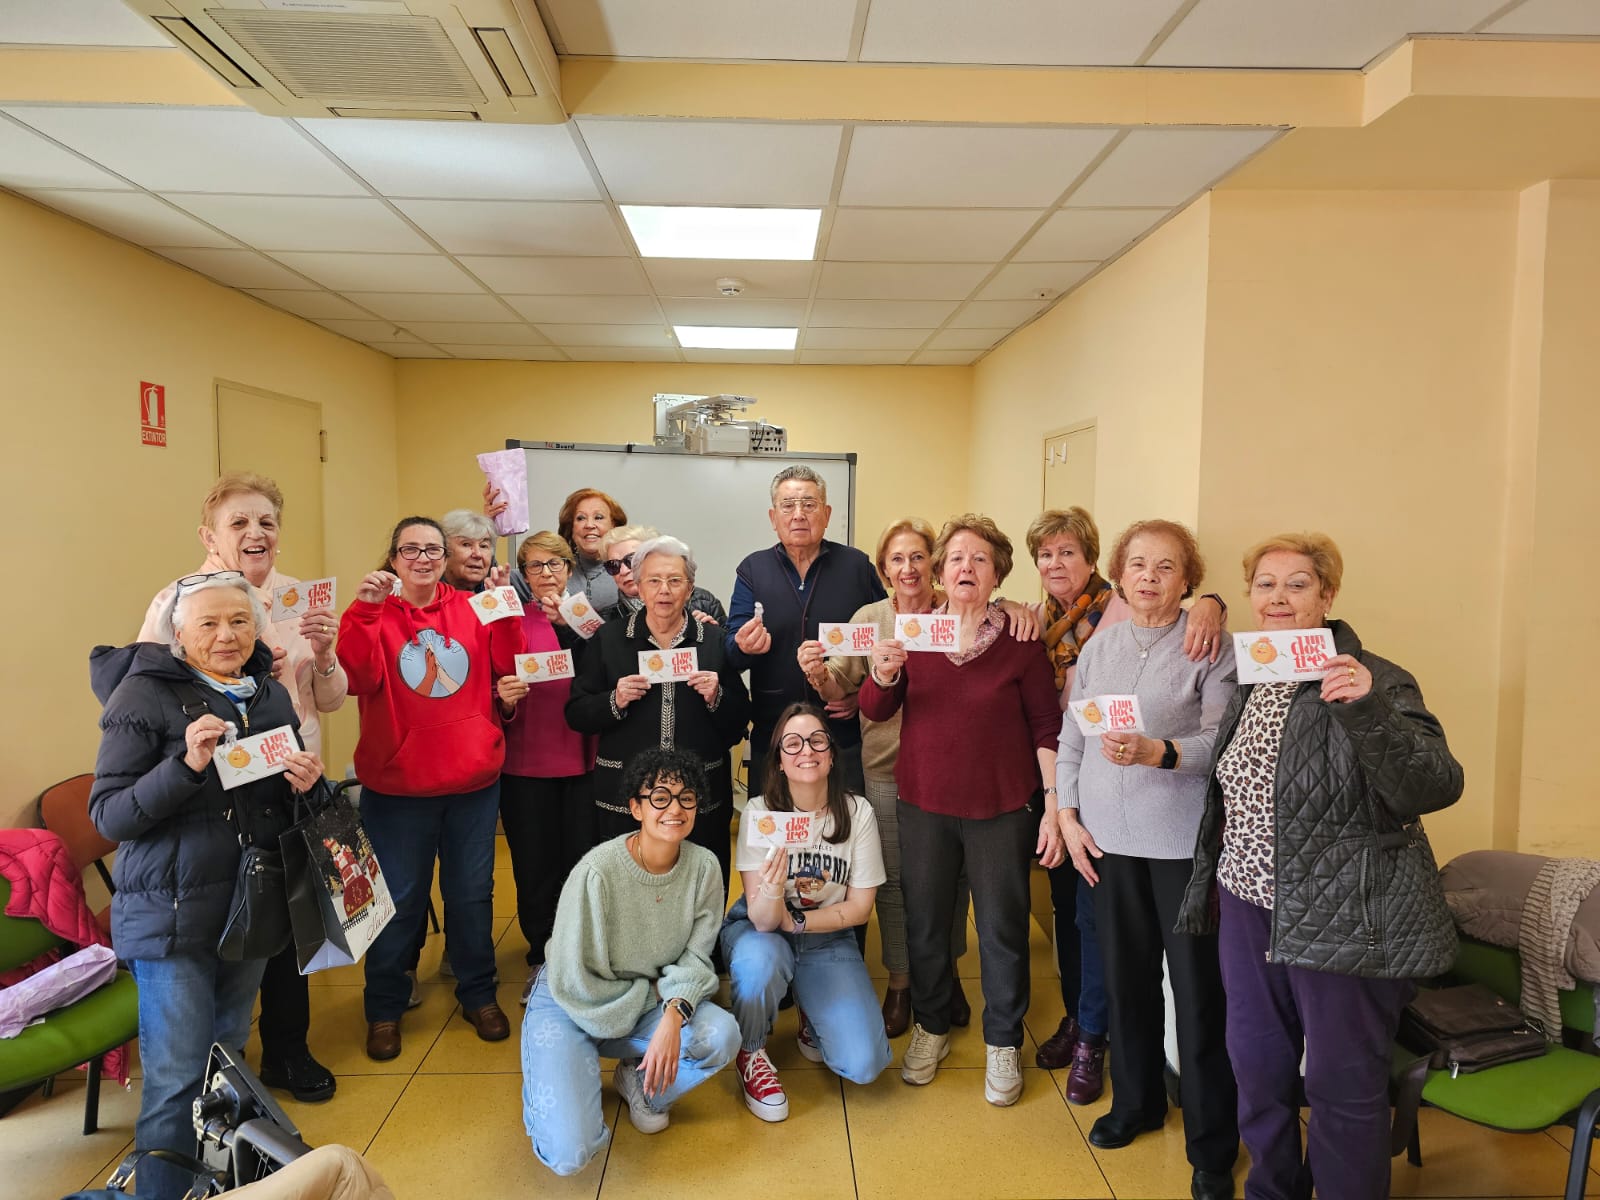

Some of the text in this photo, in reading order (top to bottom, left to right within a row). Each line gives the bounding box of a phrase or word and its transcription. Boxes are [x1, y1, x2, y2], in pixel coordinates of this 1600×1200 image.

[142, 430, 166, 443] EXTINTOR
[1290, 634, 1322, 655] dos
[1304, 634, 1327, 649] un
[1294, 652, 1330, 669] tres
